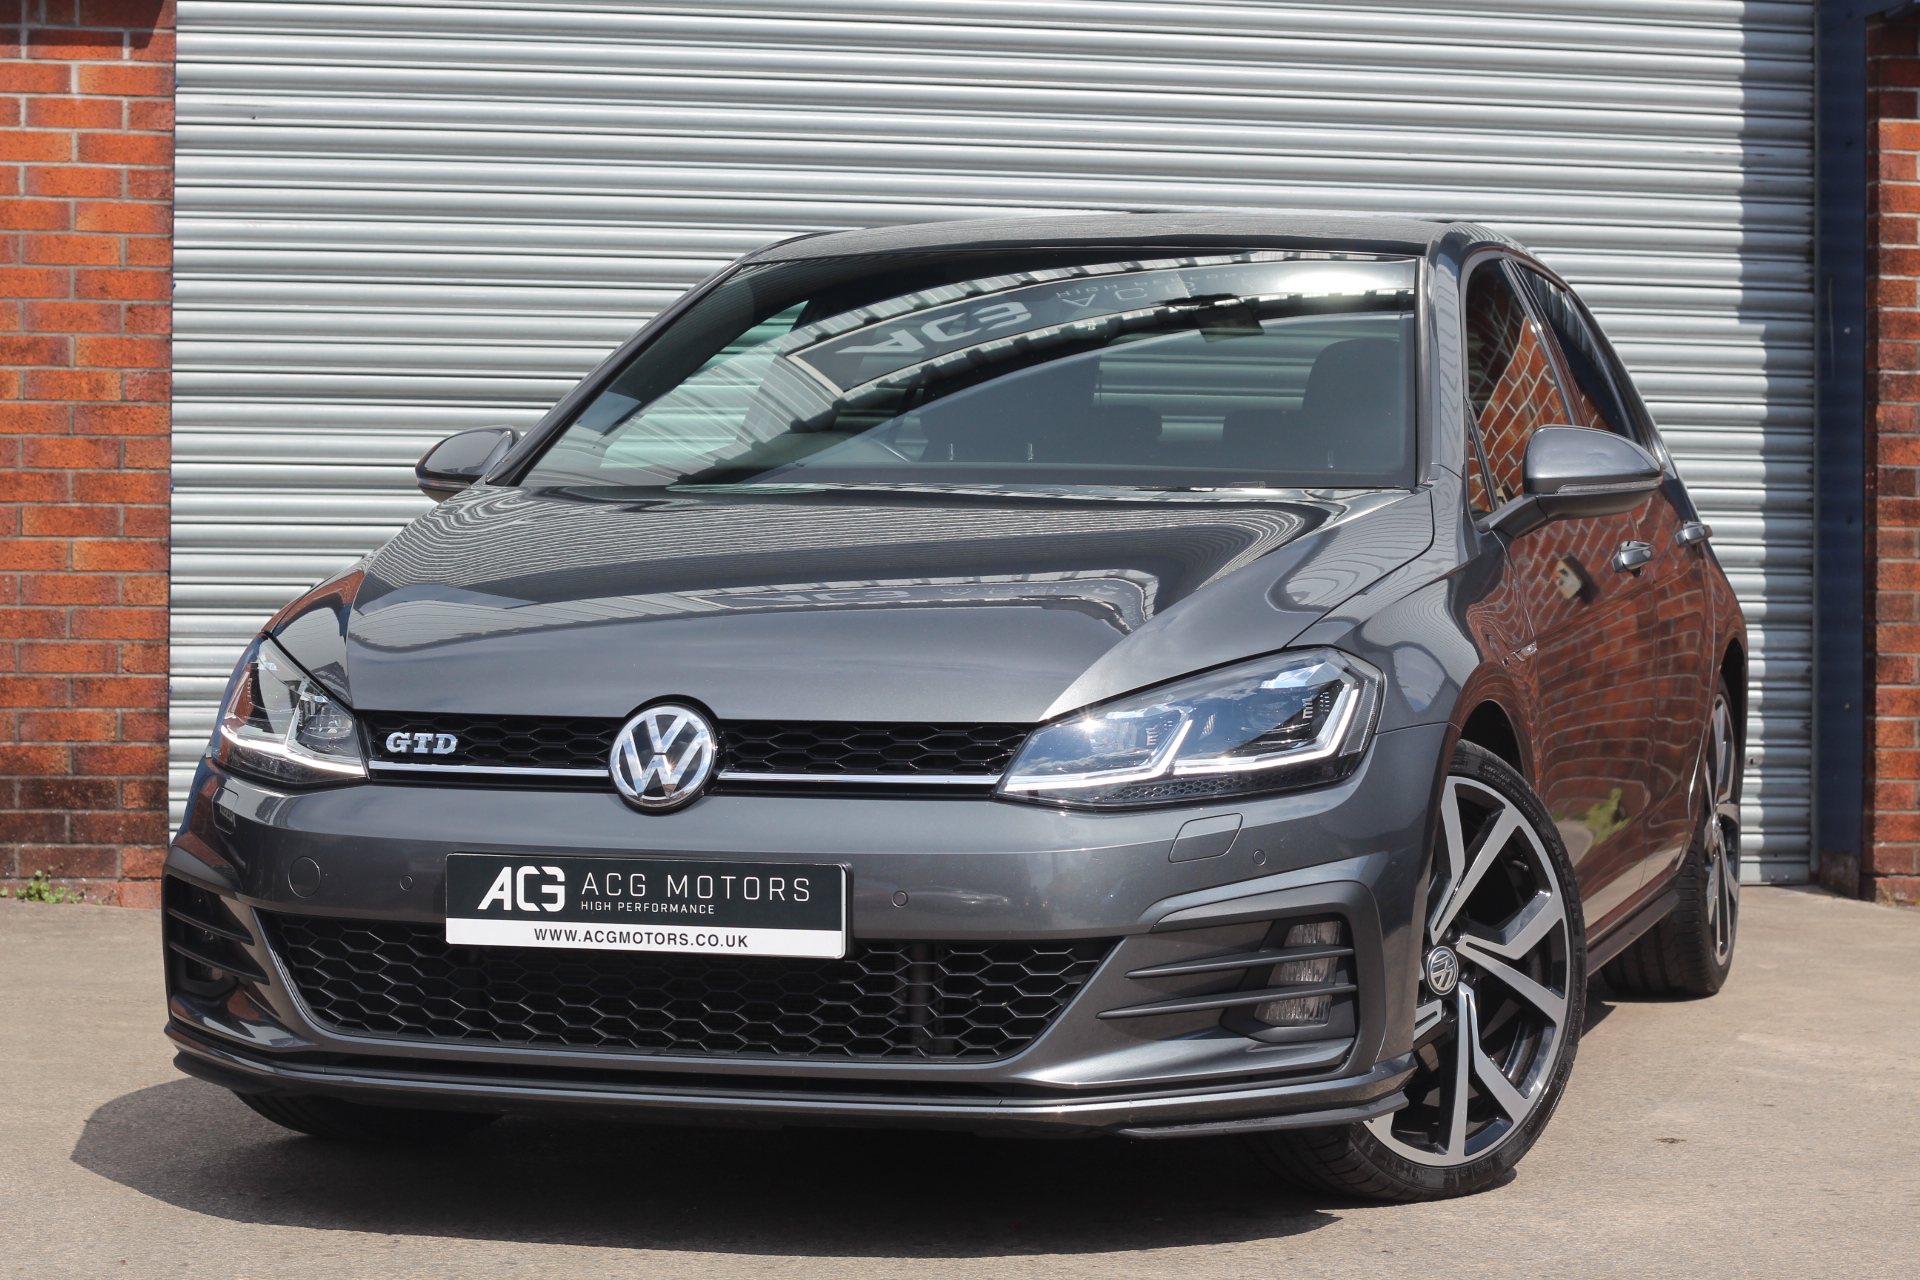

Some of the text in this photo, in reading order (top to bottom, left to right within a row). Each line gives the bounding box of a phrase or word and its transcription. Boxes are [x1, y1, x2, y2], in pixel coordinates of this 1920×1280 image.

[385, 731, 459, 755] GTD
[477, 865, 566, 913] ACG
[581, 871, 811, 902] ACG MOTORS
[581, 900, 716, 915] HIGH PERFORMANCE
[534, 927, 749, 948] WWW.ACGMOTORS.CO.UK
